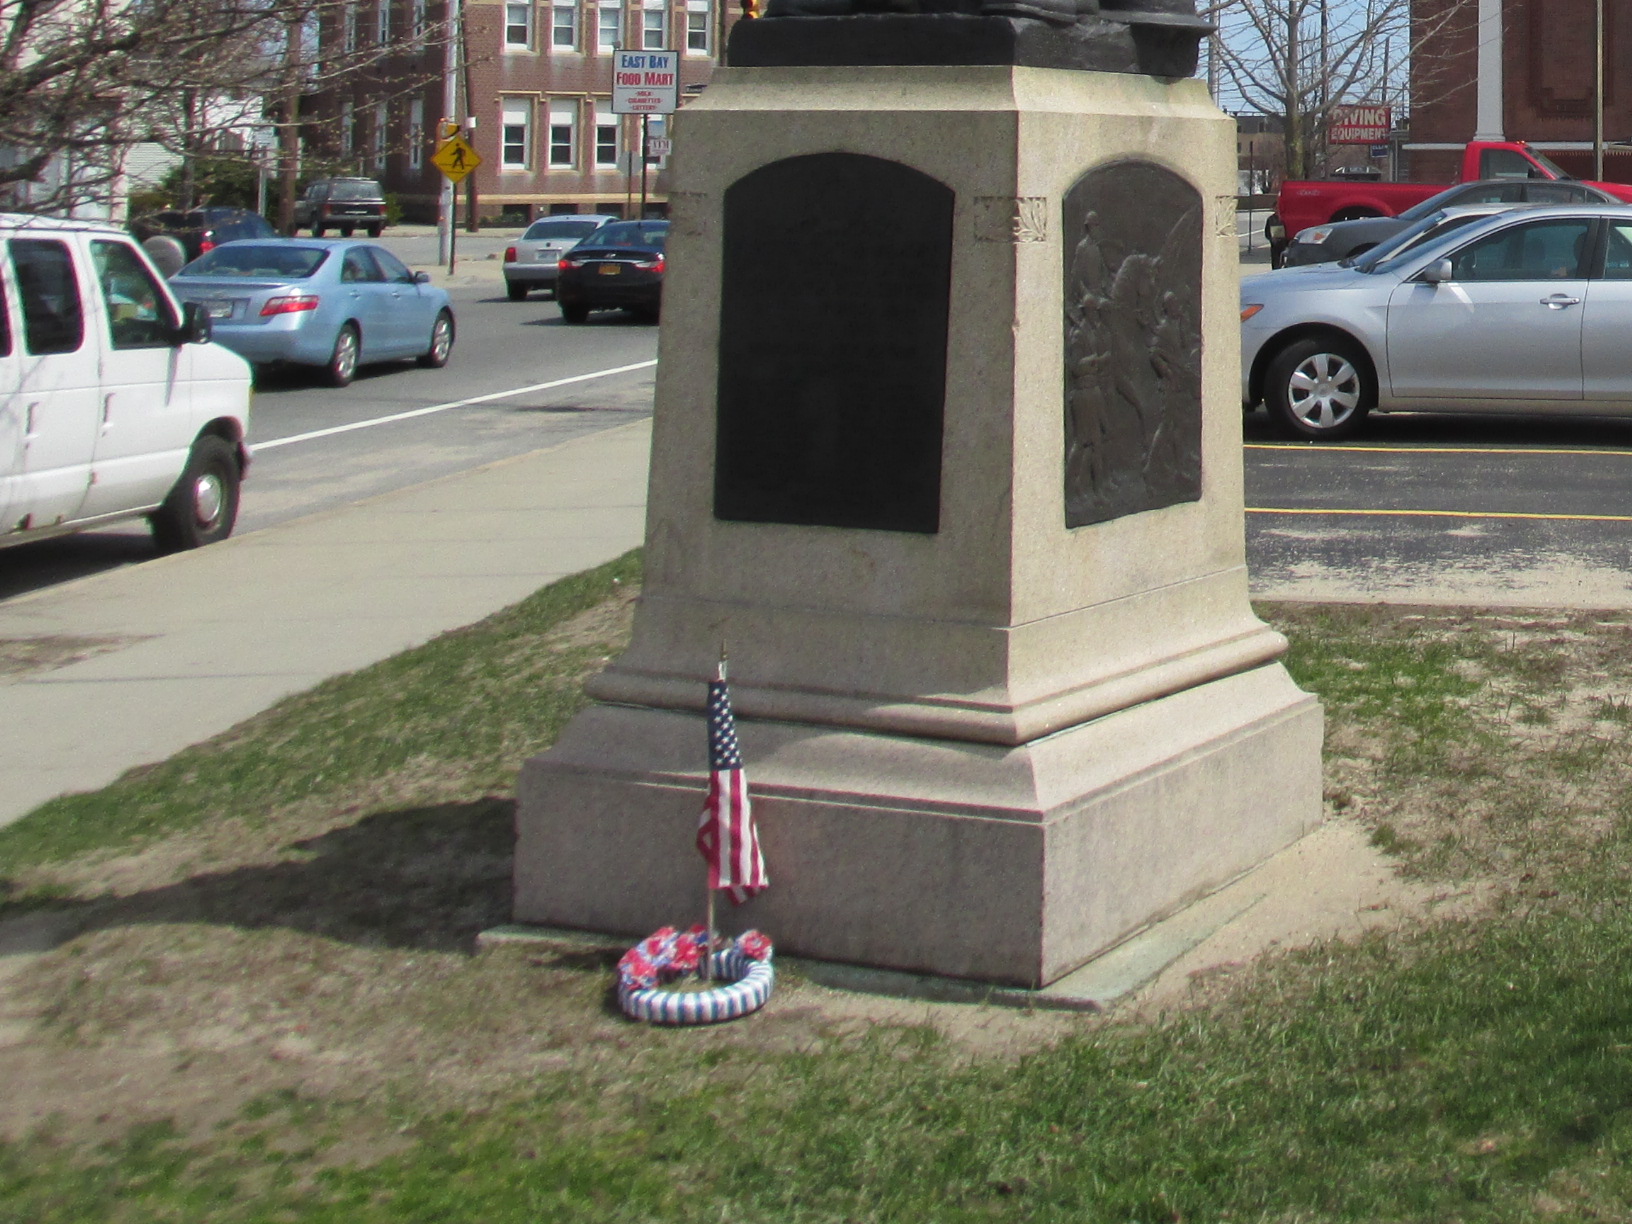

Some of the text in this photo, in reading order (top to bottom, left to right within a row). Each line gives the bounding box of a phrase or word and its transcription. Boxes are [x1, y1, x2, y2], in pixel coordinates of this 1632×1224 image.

[622, 55, 669, 68] EAST BAY
[617, 72, 674, 85] FOOD MART
[1331, 128, 1387, 140] EQUIPMENT
